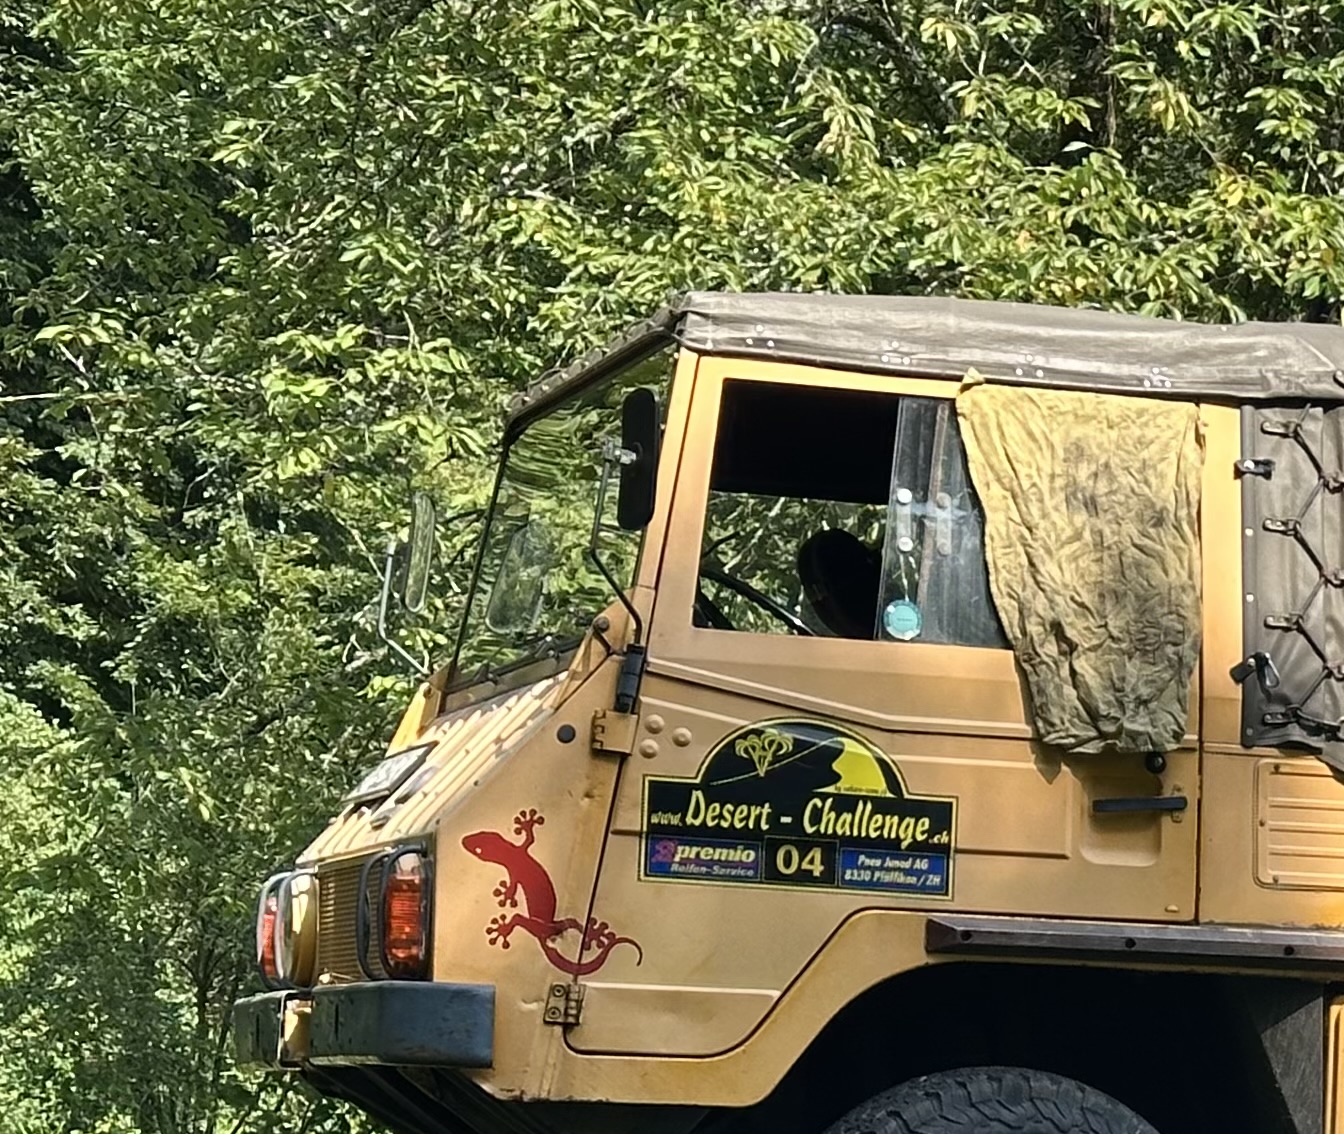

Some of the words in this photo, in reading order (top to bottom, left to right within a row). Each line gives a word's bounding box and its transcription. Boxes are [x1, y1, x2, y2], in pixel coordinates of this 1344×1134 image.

[673, 844, 756, 863] premio
[776, 843, 824, 878] 04
[913, 858, 929, 871] AG
